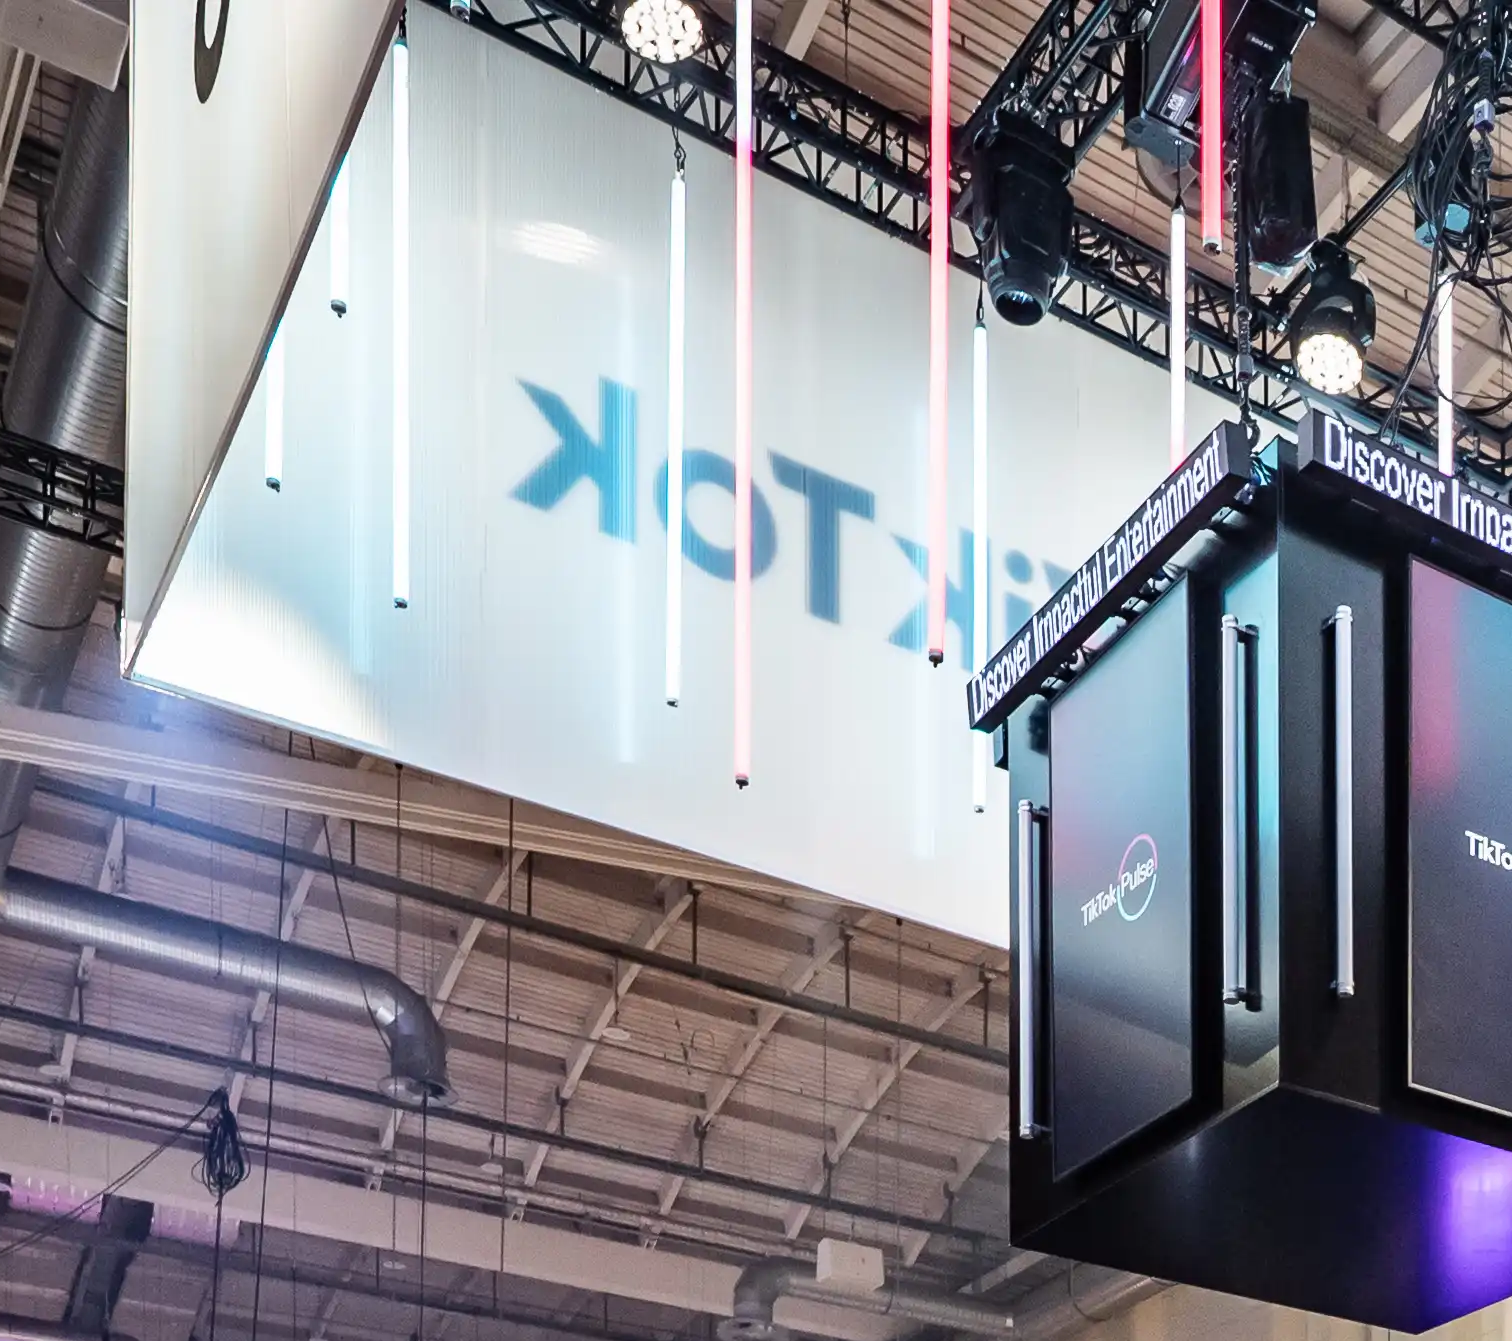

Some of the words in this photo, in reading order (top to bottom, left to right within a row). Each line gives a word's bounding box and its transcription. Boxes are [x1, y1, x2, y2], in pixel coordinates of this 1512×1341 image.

[1324, 415, 1445, 519] Discover
[972, 629, 1032, 719] Discover
[1032, 551, 1104, 659] Impactful
[1103, 430, 1224, 592] Entertainment
[1080, 883, 1117, 927] TikTok
[1120, 858, 1155, 898] Pulse
